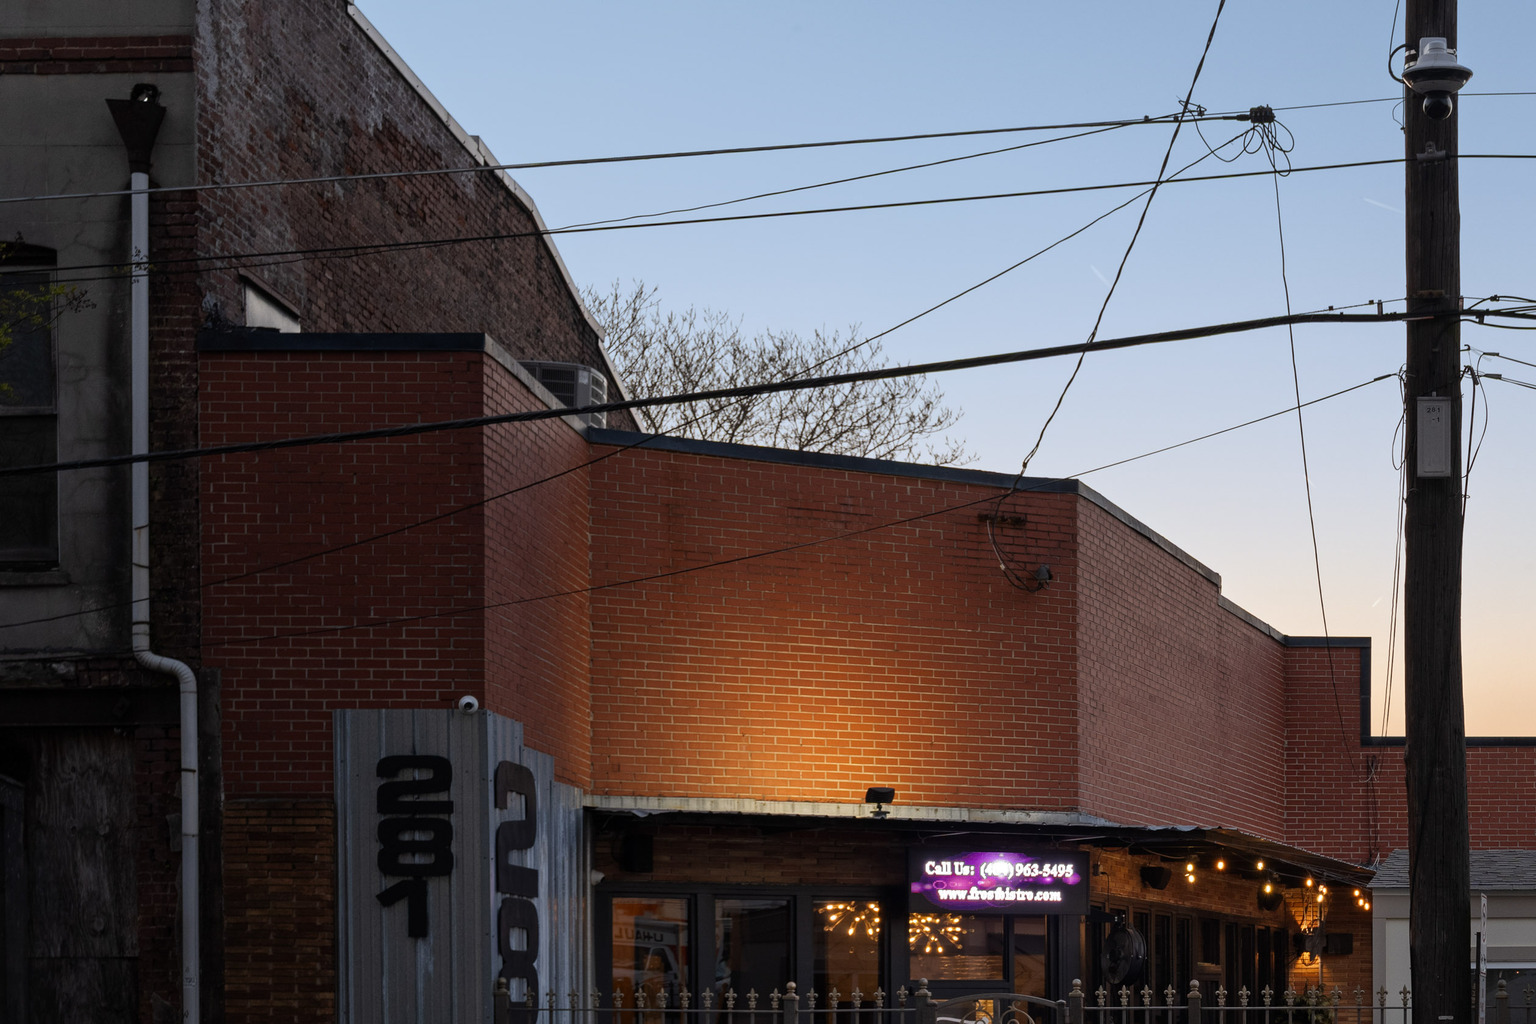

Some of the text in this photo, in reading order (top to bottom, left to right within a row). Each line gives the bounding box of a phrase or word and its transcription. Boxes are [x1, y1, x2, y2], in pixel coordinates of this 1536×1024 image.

[376, 754, 454, 938] 281
[925, 861, 952, 876] Call
[954, 861, 975, 876] Us:
